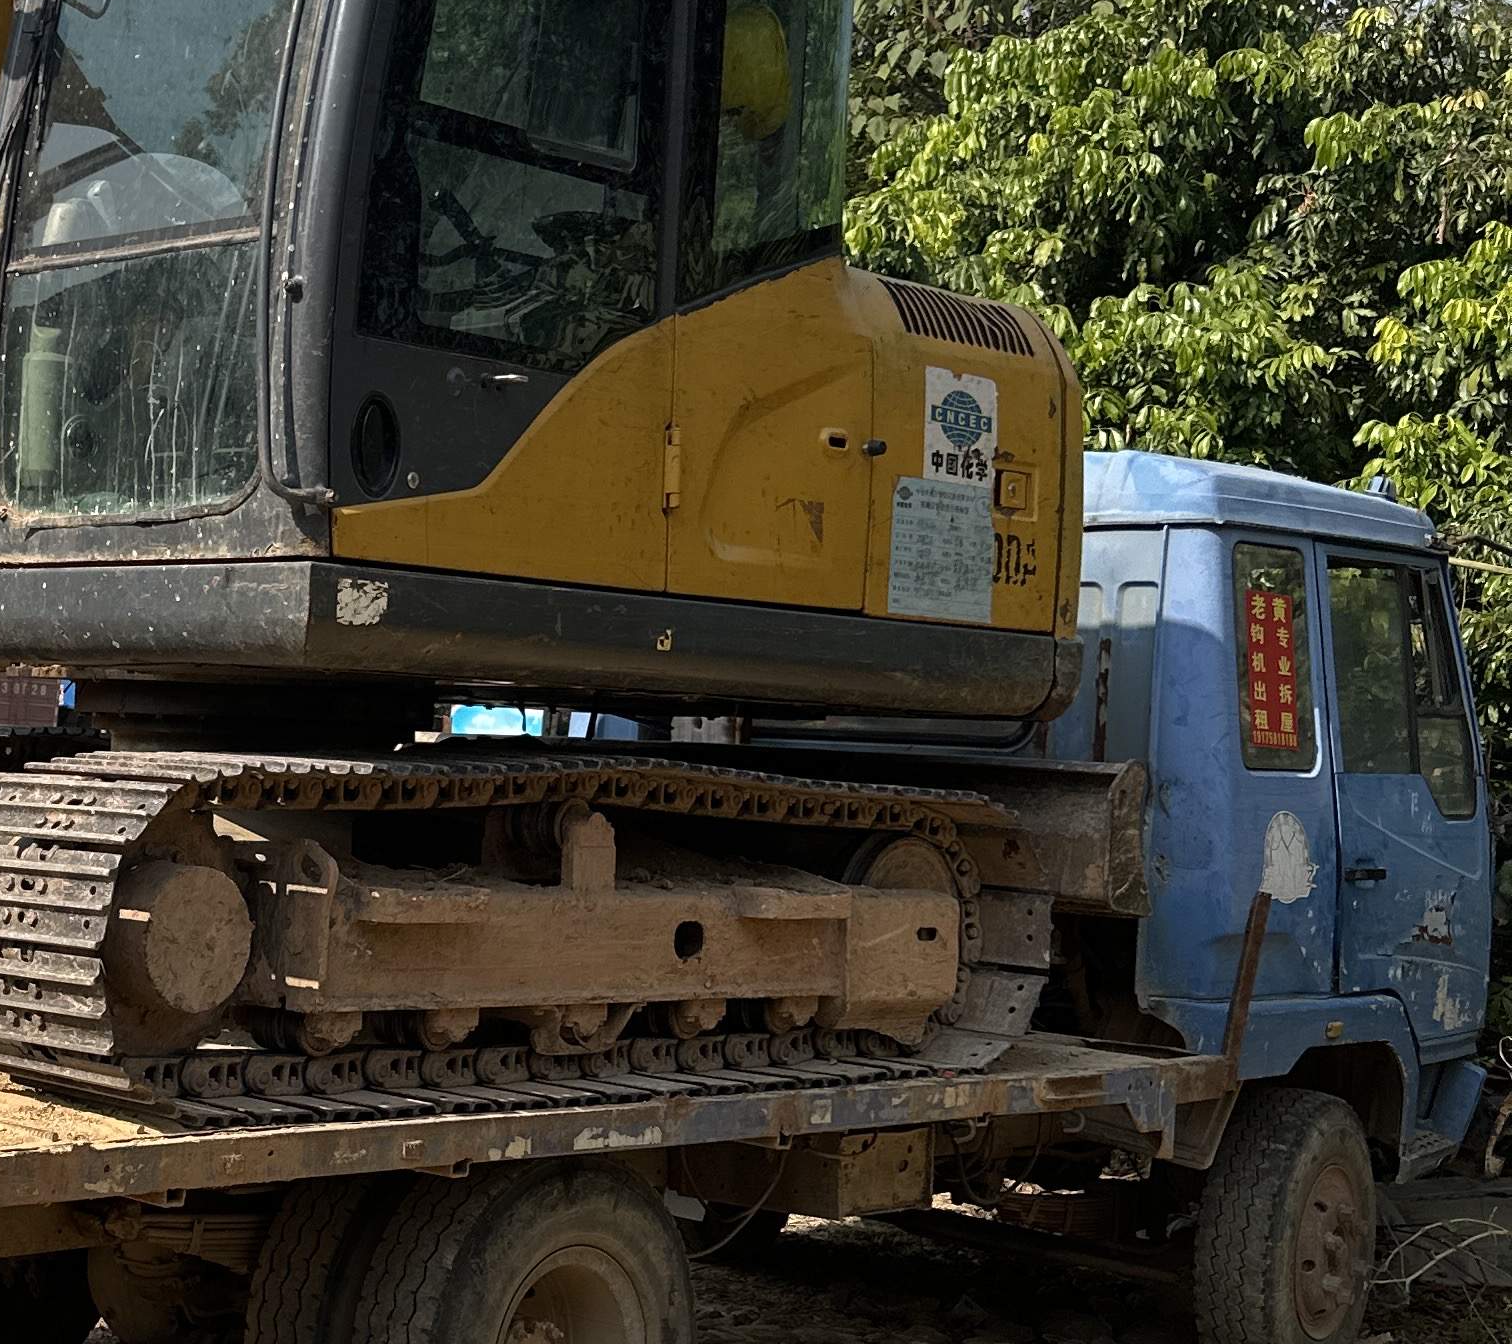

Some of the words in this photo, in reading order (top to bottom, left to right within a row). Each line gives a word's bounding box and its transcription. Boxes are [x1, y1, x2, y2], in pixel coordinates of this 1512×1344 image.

[935, 407, 989, 431] CNCEC
[931, 449, 988, 481] 中国化学
